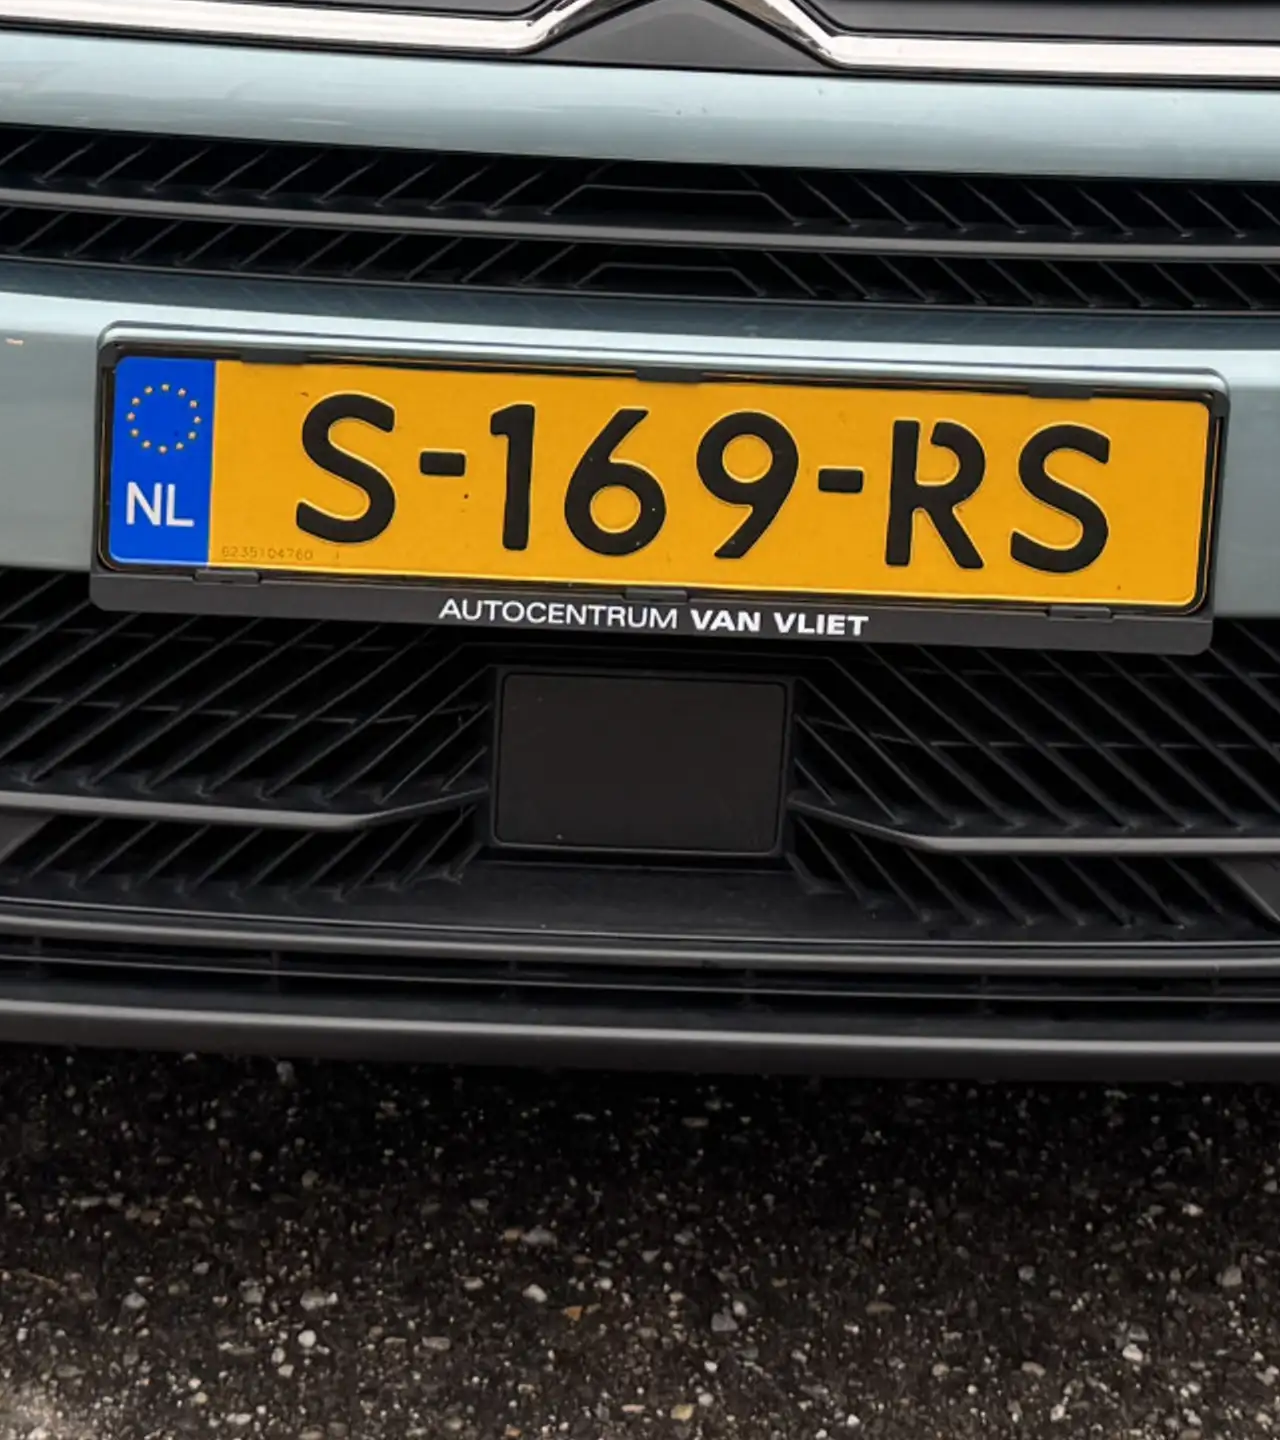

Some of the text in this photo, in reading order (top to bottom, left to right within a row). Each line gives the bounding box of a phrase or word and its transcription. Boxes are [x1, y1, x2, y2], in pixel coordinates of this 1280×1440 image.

[126, 481, 195, 527] NL
[295, 391, 1111, 574] S-169-RS
[438, 598, 870, 636] AUTOCENTRUM VAN VLIET
